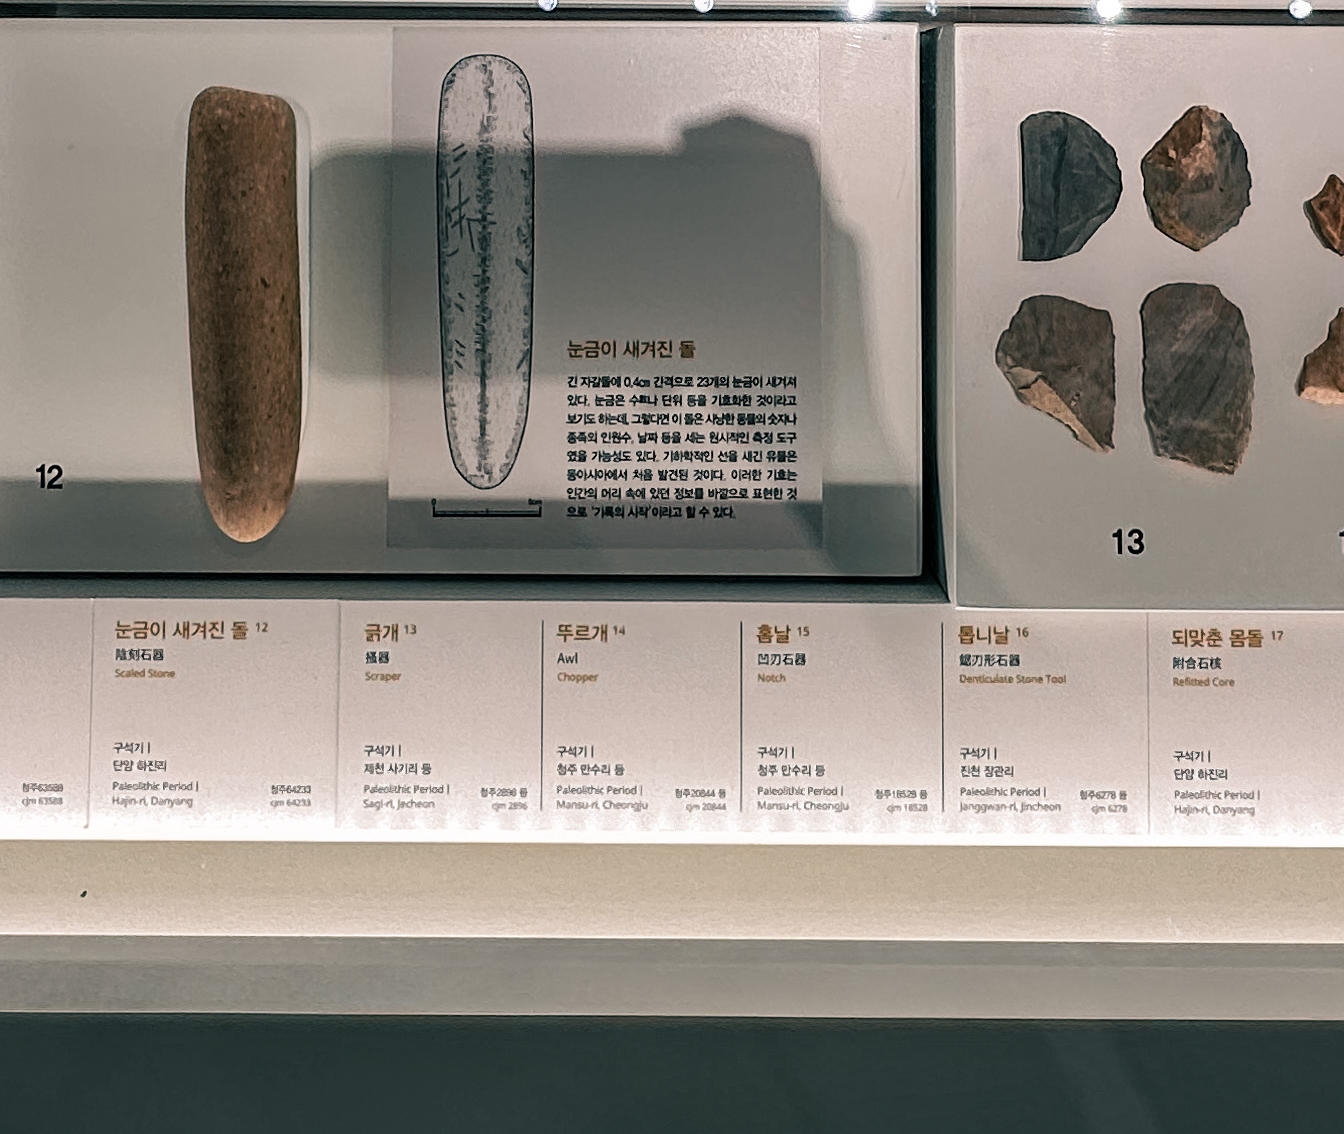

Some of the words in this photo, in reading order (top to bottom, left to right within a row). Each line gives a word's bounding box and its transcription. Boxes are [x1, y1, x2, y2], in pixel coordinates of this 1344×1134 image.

[567, 340, 616, 358] 눈금이
[622, 339, 673, 359] 새겨진
[678, 340, 696, 359] 돌
[35, 464, 63, 490] 12
[1111, 528, 1145, 555] 13
[114, 620, 166, 640] 눈금이
[172, 620, 224, 640] 새겨진
[231, 621, 248, 640] 돌
[256, 622, 268, 632] 12
[364, 623, 399, 642] 긁개
[404, 624, 417, 635] 13
[556, 624, 608, 643] 뚜르개
[613, 625, 626, 636] 14
[756, 624, 792, 644] 홈날
[797, 626, 810, 637] 15
[958, 625, 1010, 645] 톱니날
[1016, 627, 1029, 638] 16
[1171, 628, 1223, 648] 되맞춘
[1228, 629, 1264, 648] 몸돌
[1271, 630, 1284, 641] 17
[556, 652, 578, 664] Awl
[114, 668, 146, 678] Scaled
[147, 668, 176, 678] Stone
[364, 671, 402, 684] Scraper
[557, 672, 599, 684] Chopper
[757, 673, 786, 683] Notch
[959, 673, 1014, 684] Denticulate
[1015, 674, 1044, 684] Stone
[1045, 674, 1067, 684] Tool
[1172, 676, 1210, 687] Refitted
[1212, 676, 1235, 688] Core
[113, 742, 144, 754] 구석기
[364, 744, 395, 757] 구석기
[556, 746, 588, 758] 구석기
[757, 746, 788, 759] 구석기
[960, 747, 990, 760] 구석기
[1173, 750, 1204, 763] 구석기
